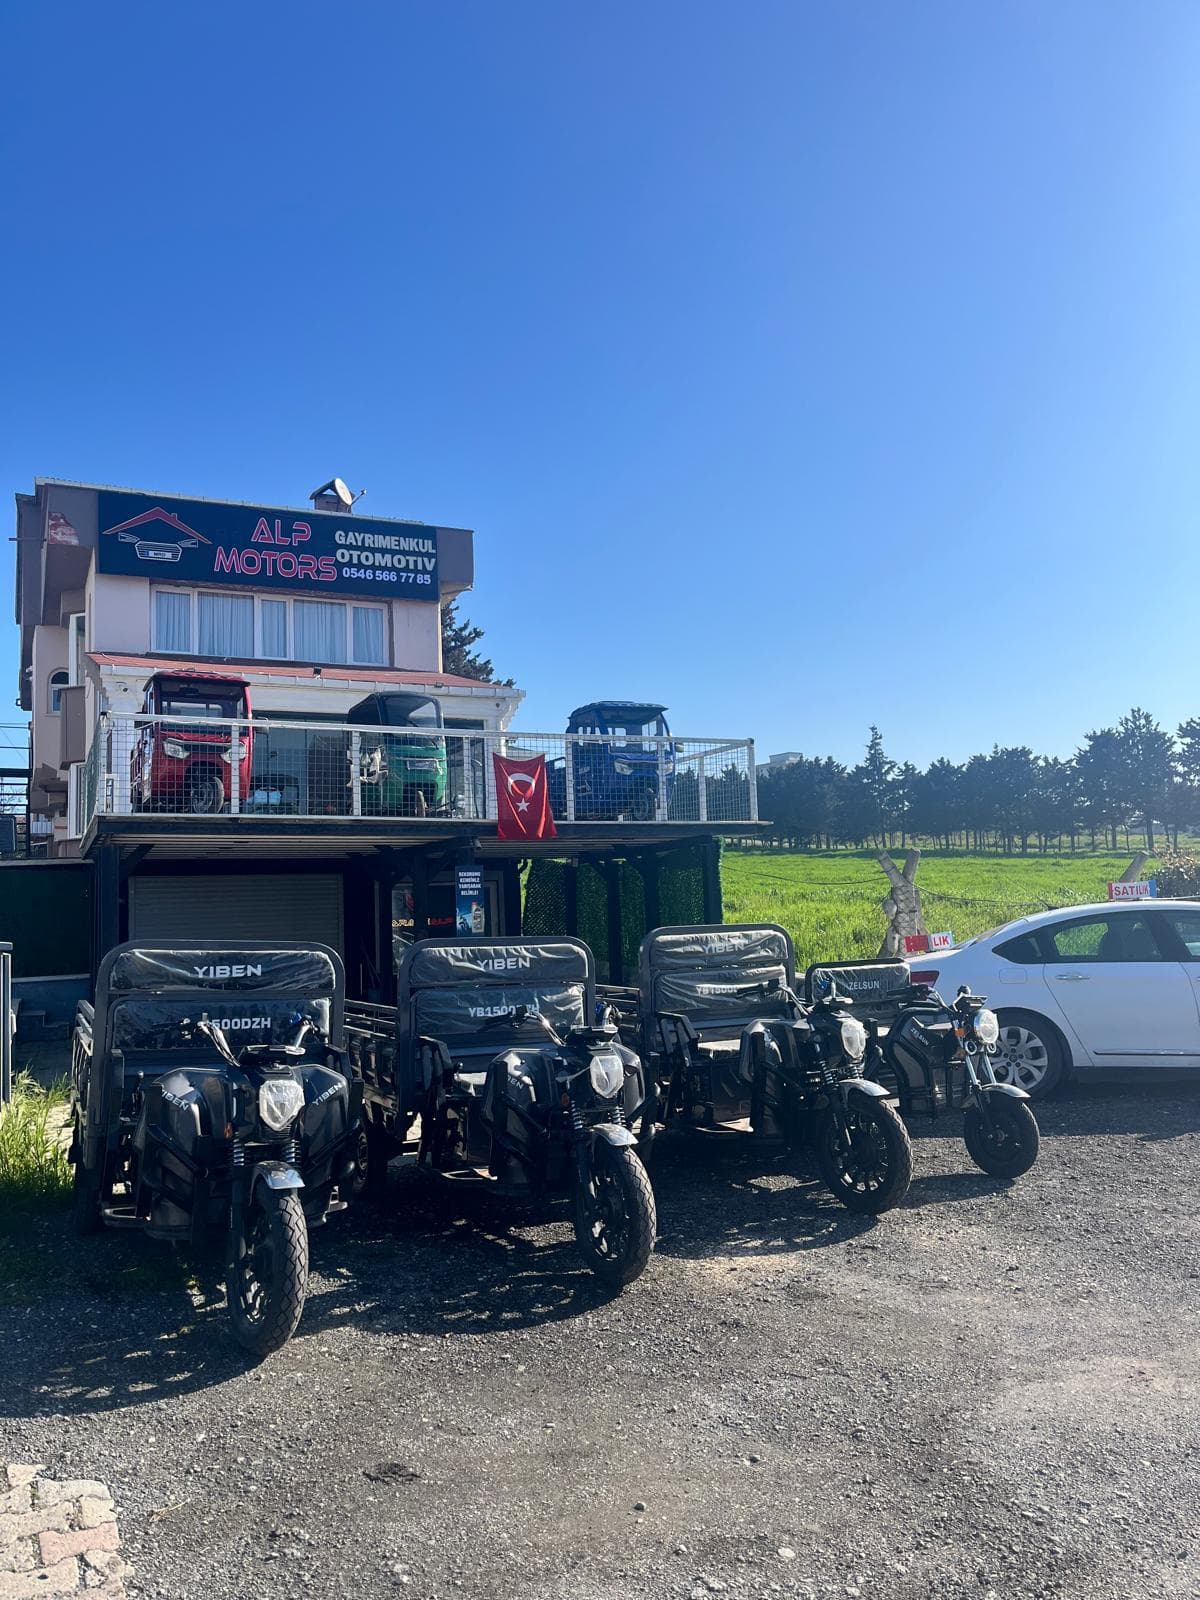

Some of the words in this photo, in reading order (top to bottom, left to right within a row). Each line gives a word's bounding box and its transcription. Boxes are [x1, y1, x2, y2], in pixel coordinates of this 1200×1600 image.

[251, 517, 312, 546] ALP
[334, 530, 436, 553] GAYRIMENKUL
[214, 546, 338, 581] MOTORS
[336, 548, 436, 571] OTOMOTIV
[342, 567, 374, 580] 0546
[375, 570, 398, 582] 566
[399, 572, 415, 583] 77
[416, 574, 432, 585] 85
[1114, 884, 1149, 896] SATILIK
[702, 943, 745, 955] YIBEN
[193, 964, 262, 979] YIBEN
[477, 957, 530, 970] YIBEN
[848, 980, 880, 991] ZELSUN
[211, 1017, 271, 1030] 500DZH
[161, 1090, 189, 1111] IBEN
[311, 1082, 342, 1106] YIBEN
